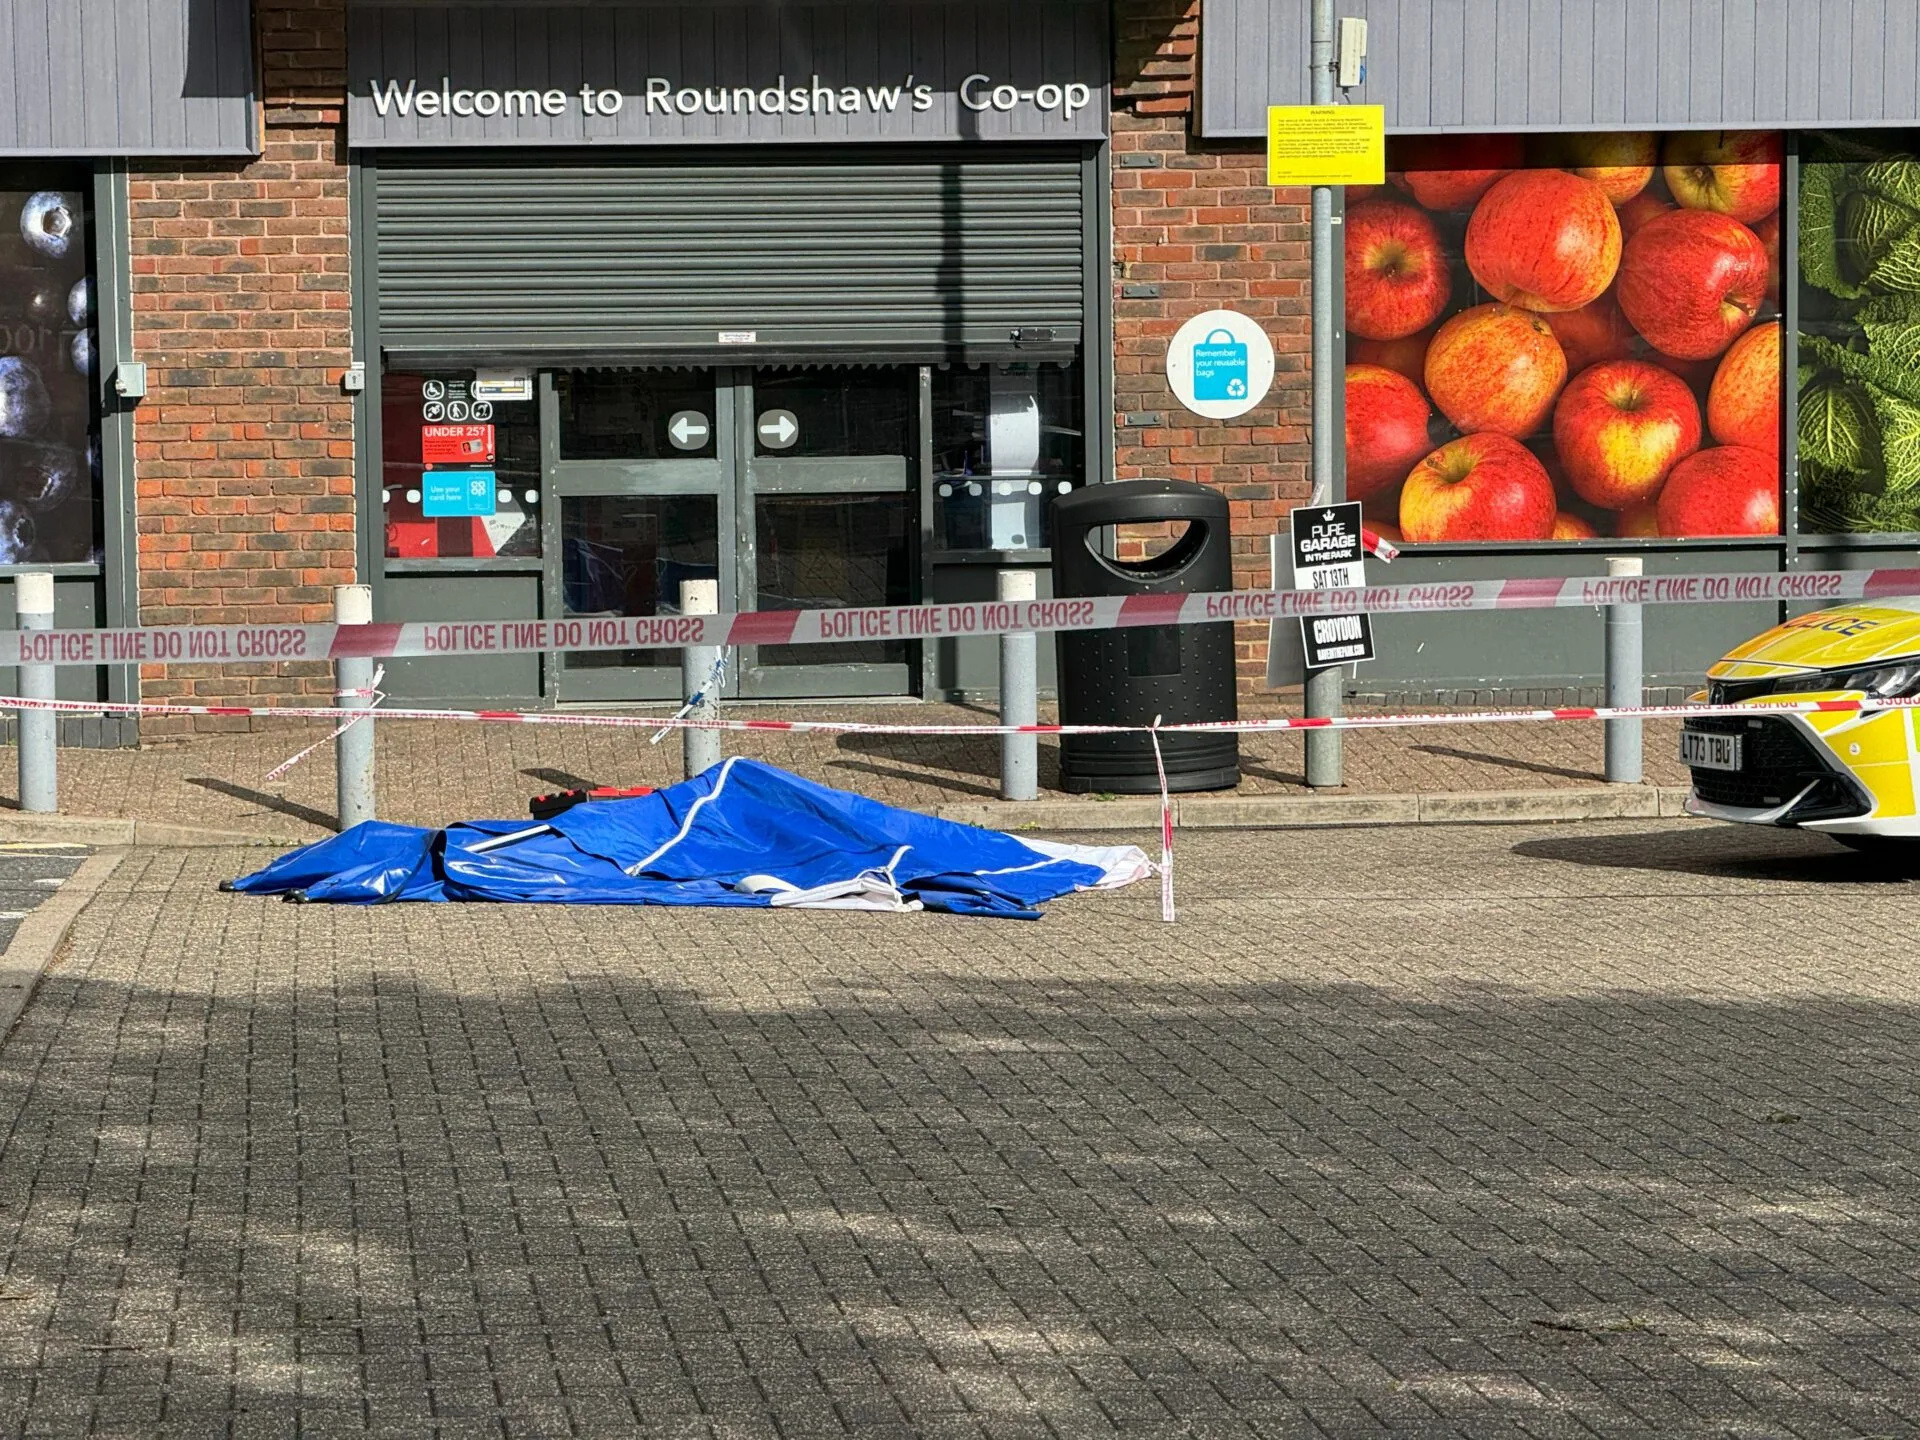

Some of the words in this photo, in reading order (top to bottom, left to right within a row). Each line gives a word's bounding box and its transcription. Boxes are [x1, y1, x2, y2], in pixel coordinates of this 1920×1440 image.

[370, 76, 567, 116] Welcome
[579, 83, 623, 115] to
[646, 74, 933, 114] Roundshaw's
[959, 74, 1090, 119] Co-op
[1196, 349, 1237, 357] Remember
[1196, 360, 1212, 368] your
[1214, 358, 1245, 366] reusable
[1196, 369, 1214, 378] bags
[424, 426, 463, 437] UNDER
[466, 426, 486, 437] 25?
[1311, 522, 1346, 538] PURE
[1300, 534, 1356, 552] GARAGE
[1312, 570, 1328, 589] SAT
[1330, 567, 1350, 587] 13TH
[1313, 615, 1363, 644] CROYDON
[1683, 733, 1705, 761] LT73
[1708, 737, 1730, 764] TBU
